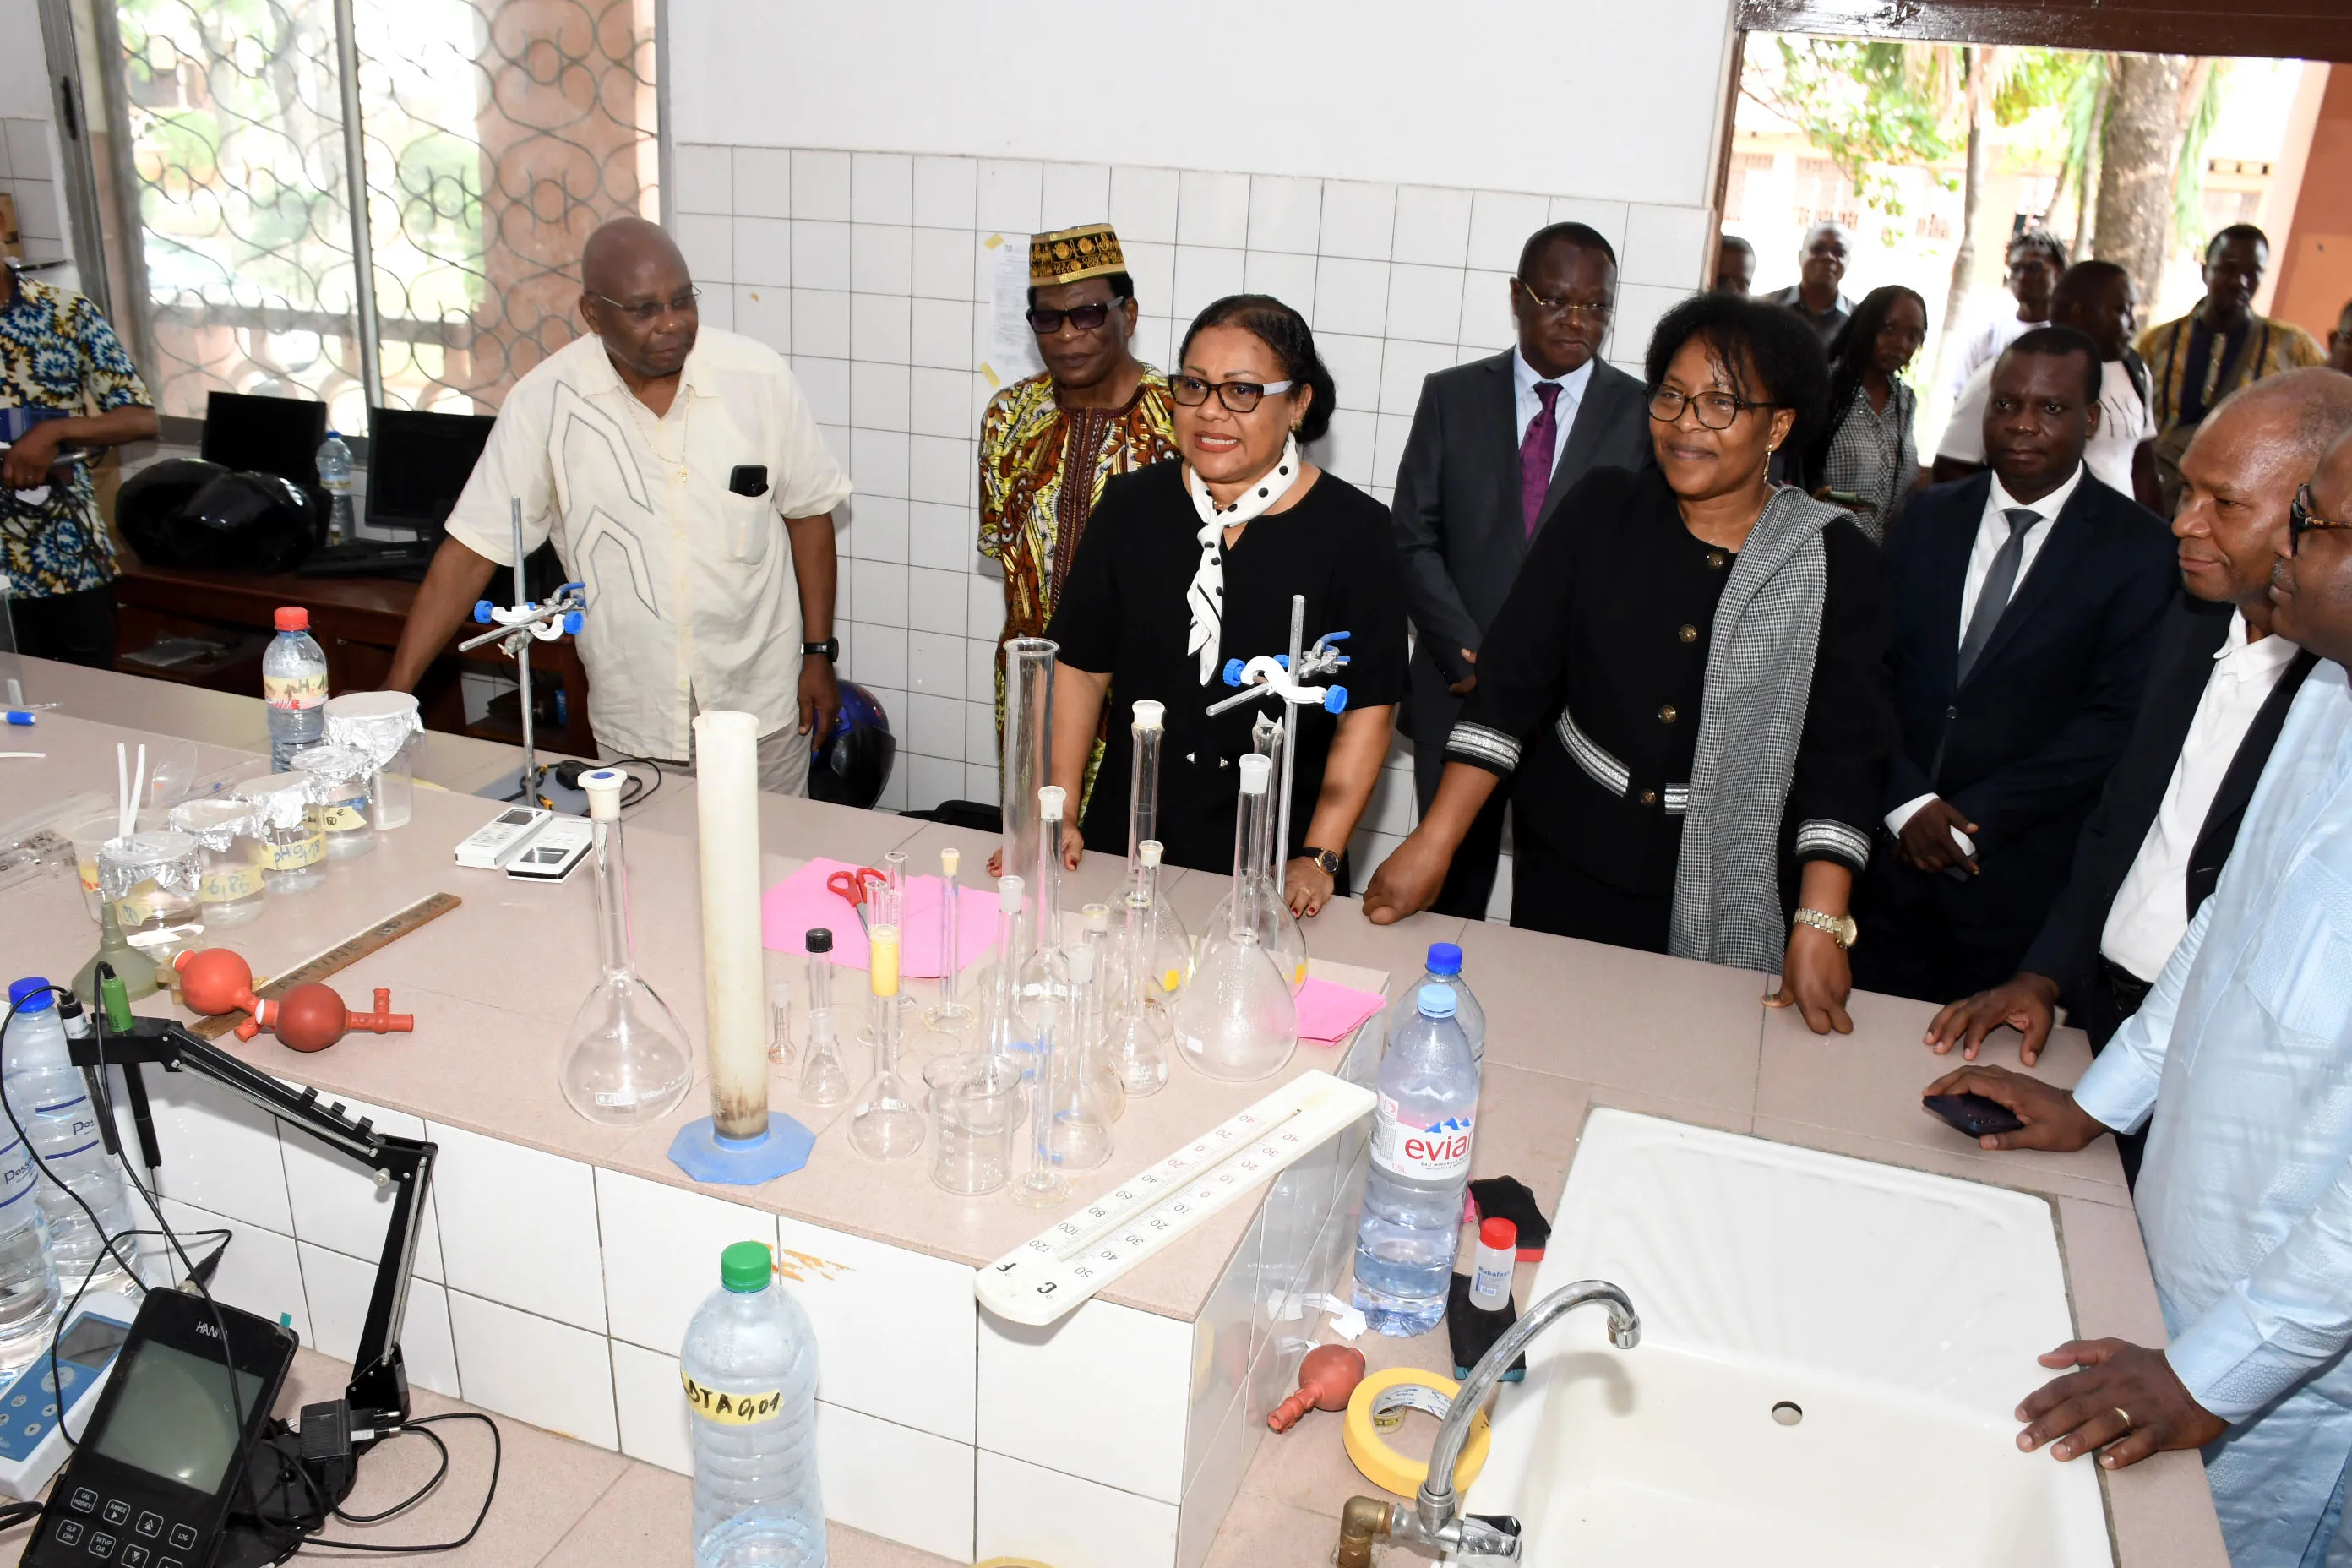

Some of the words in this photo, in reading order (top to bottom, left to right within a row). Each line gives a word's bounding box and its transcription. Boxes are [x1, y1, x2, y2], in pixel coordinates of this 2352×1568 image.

[1216, 1130, 1233, 1139] 20
[1282, 1134, 1298, 1142] 40
[1262, 1147, 1279, 1157] 30
[1167, 1159, 1184, 1168] 20
[1241, 1161, 1259, 1171] 20
[1141, 1174, 1158, 1184] 40
[1219, 1175, 1235, 1185] 10
[1115, 1190, 1133, 1200] 60
[1088, 1207, 1105, 1217] 80
[1173, 1204, 1190, 1214] 10
[1058, 1222, 1079, 1235] 100
[1150, 1219, 1168, 1230] 20
[1126, 1235, 1144, 1246] 30
[1029, 1240, 1049, 1253] 120
[1101, 1250, 1119, 1260] 40
[1075, 1267, 1093, 1278] 50
[683, 1379, 732, 1414] DTA
[738, 1392, 781, 1421] 0,01
[74, 1499, 92, 1510] MODIFY
[110, 1502, 127, 1513] RANGE
[96, 1536, 112, 1546] SETUP
[177, 1533, 189, 1542] LOG
[95, 1545, 106, 1554] CLR
